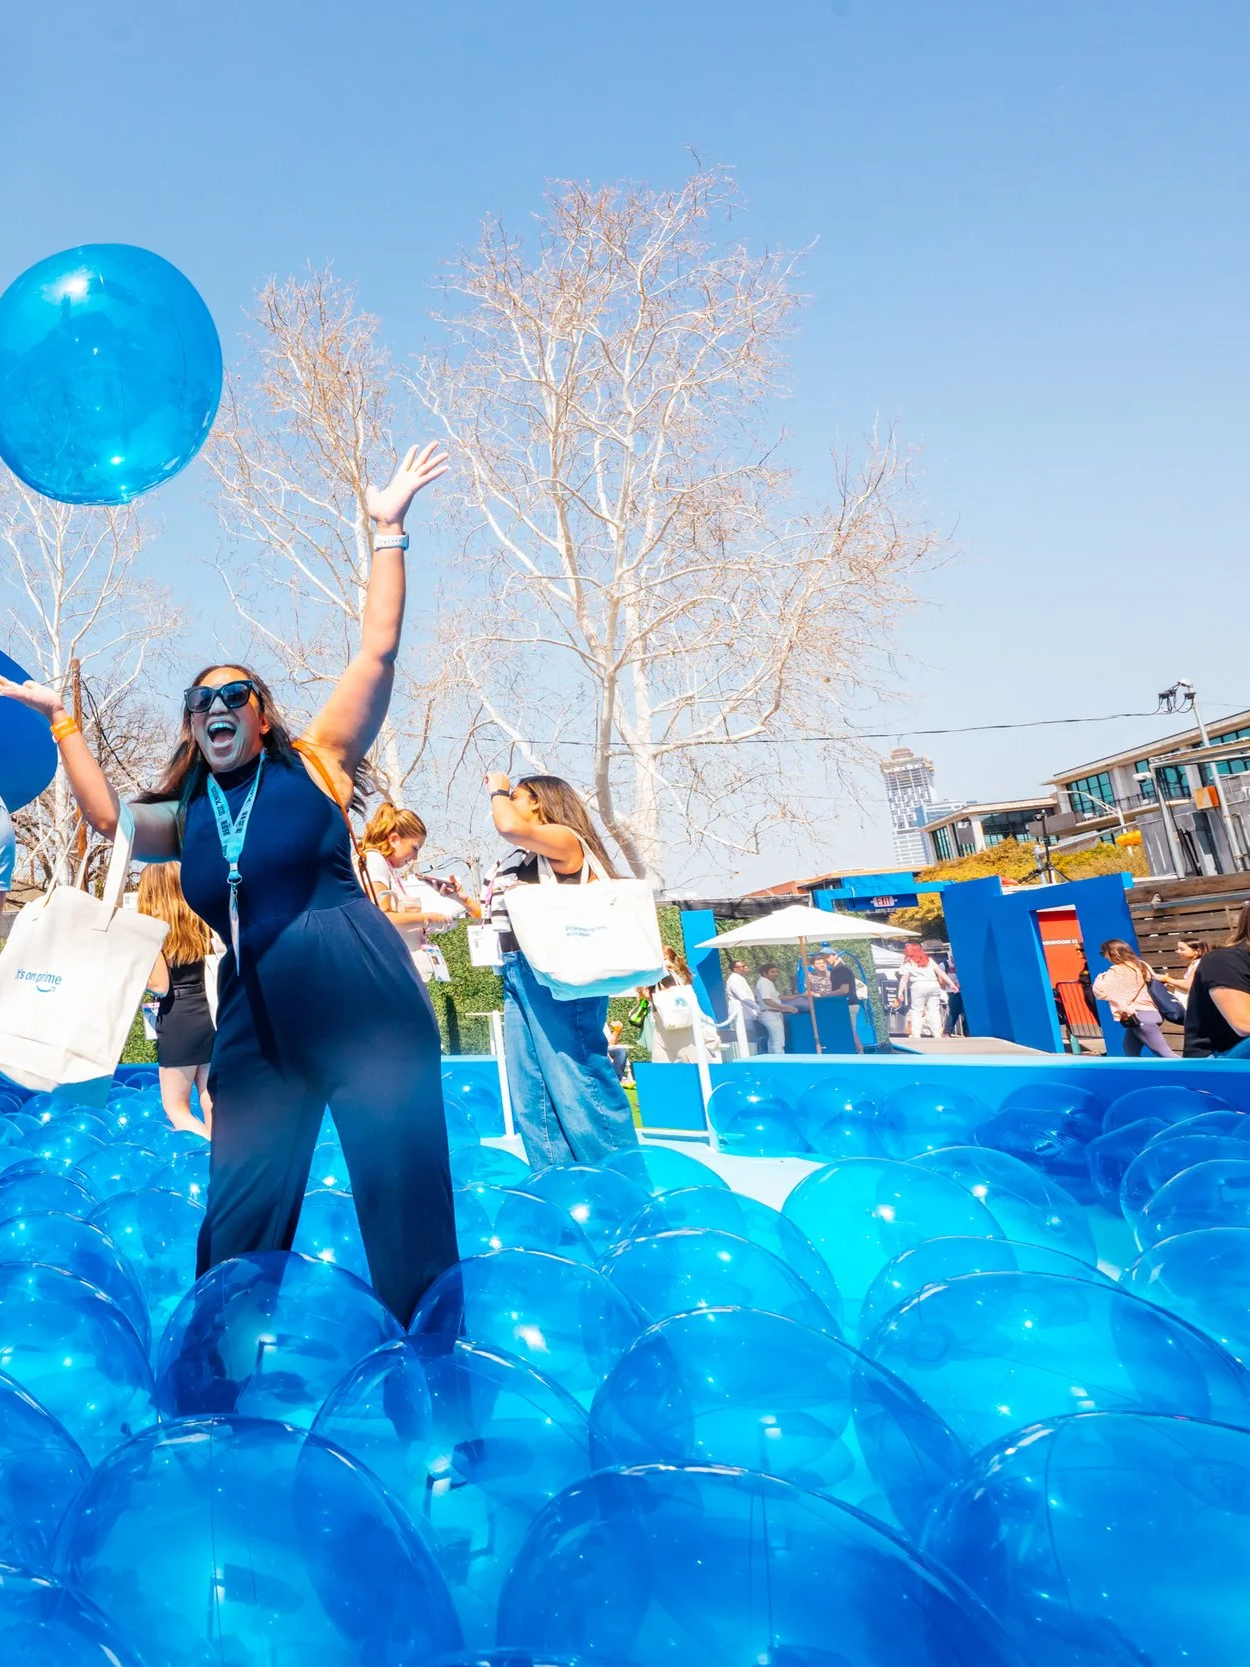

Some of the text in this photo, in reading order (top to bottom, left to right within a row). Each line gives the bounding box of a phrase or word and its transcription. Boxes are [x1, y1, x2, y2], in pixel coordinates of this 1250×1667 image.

[15, 968, 62, 985] It's on prime
